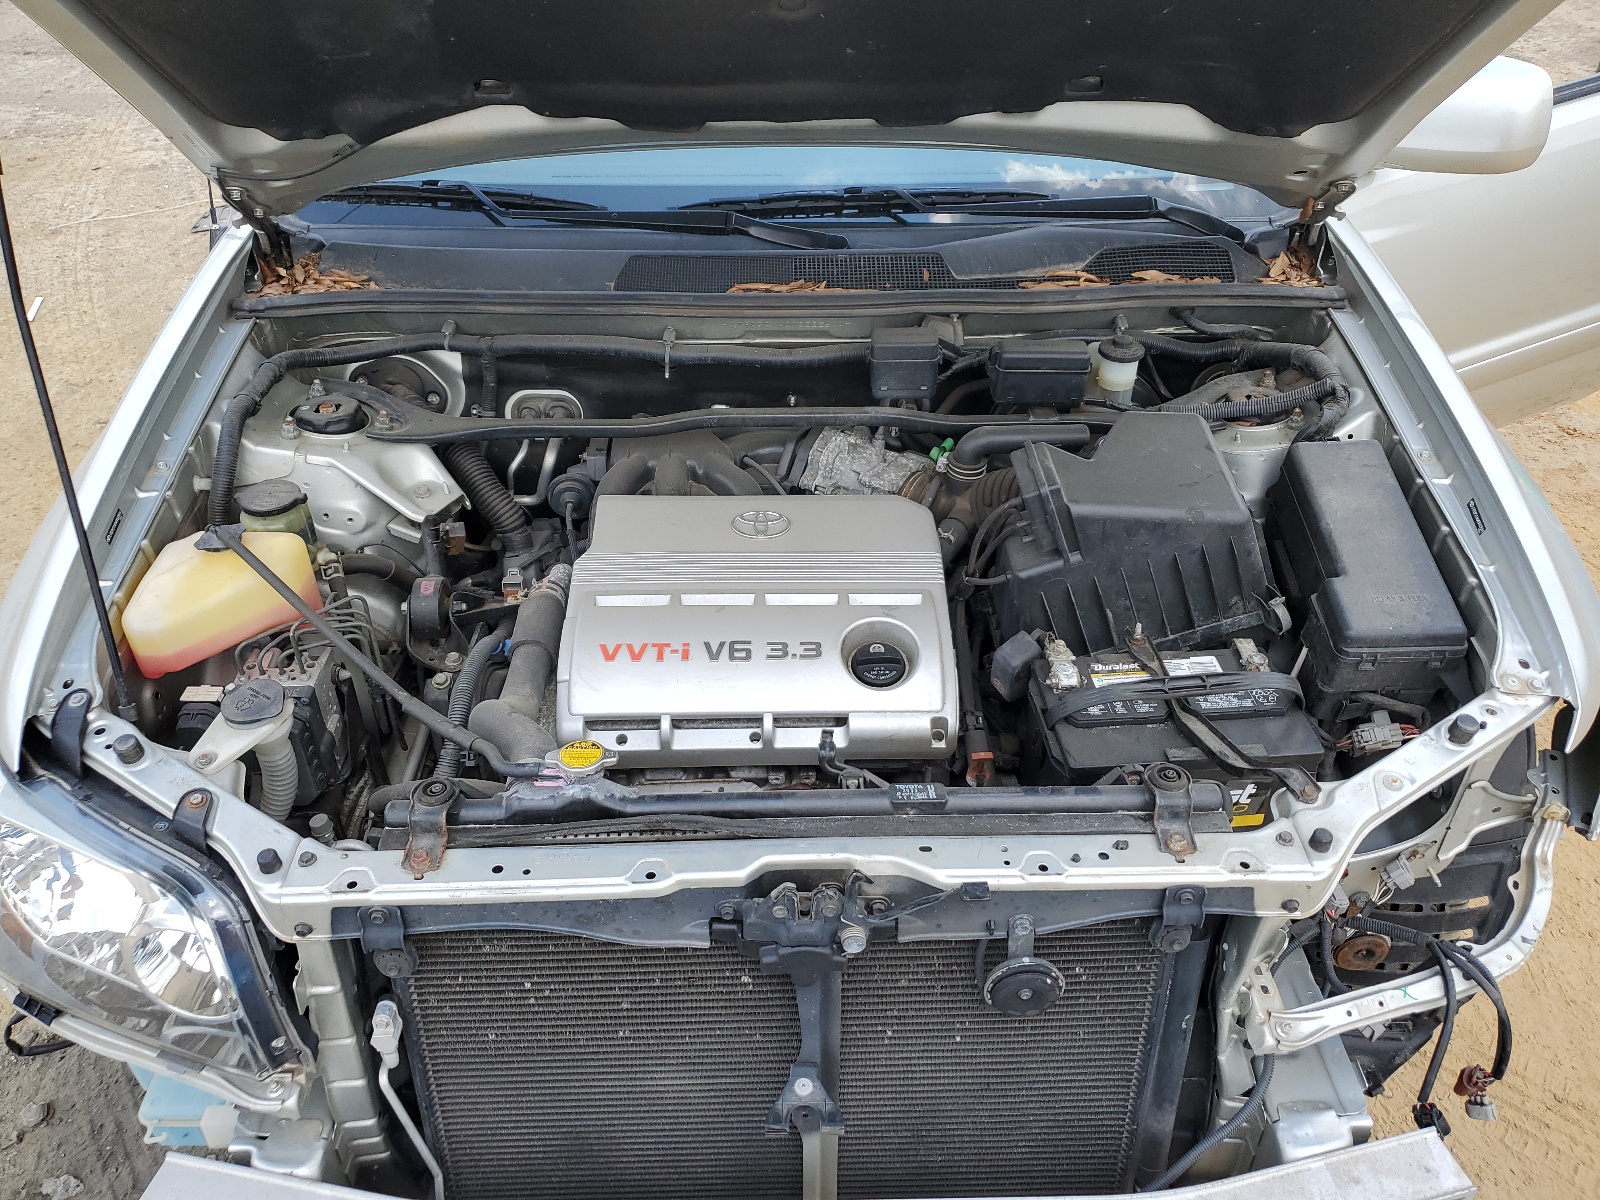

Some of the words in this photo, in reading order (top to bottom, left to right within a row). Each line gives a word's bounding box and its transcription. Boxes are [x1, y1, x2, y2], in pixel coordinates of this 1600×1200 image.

[598, 641, 692, 663] VVT-i
[703, 640, 753, 663] V6
[765, 641, 824, 661] 3.3
[1091, 662, 1141, 671] Duralast
